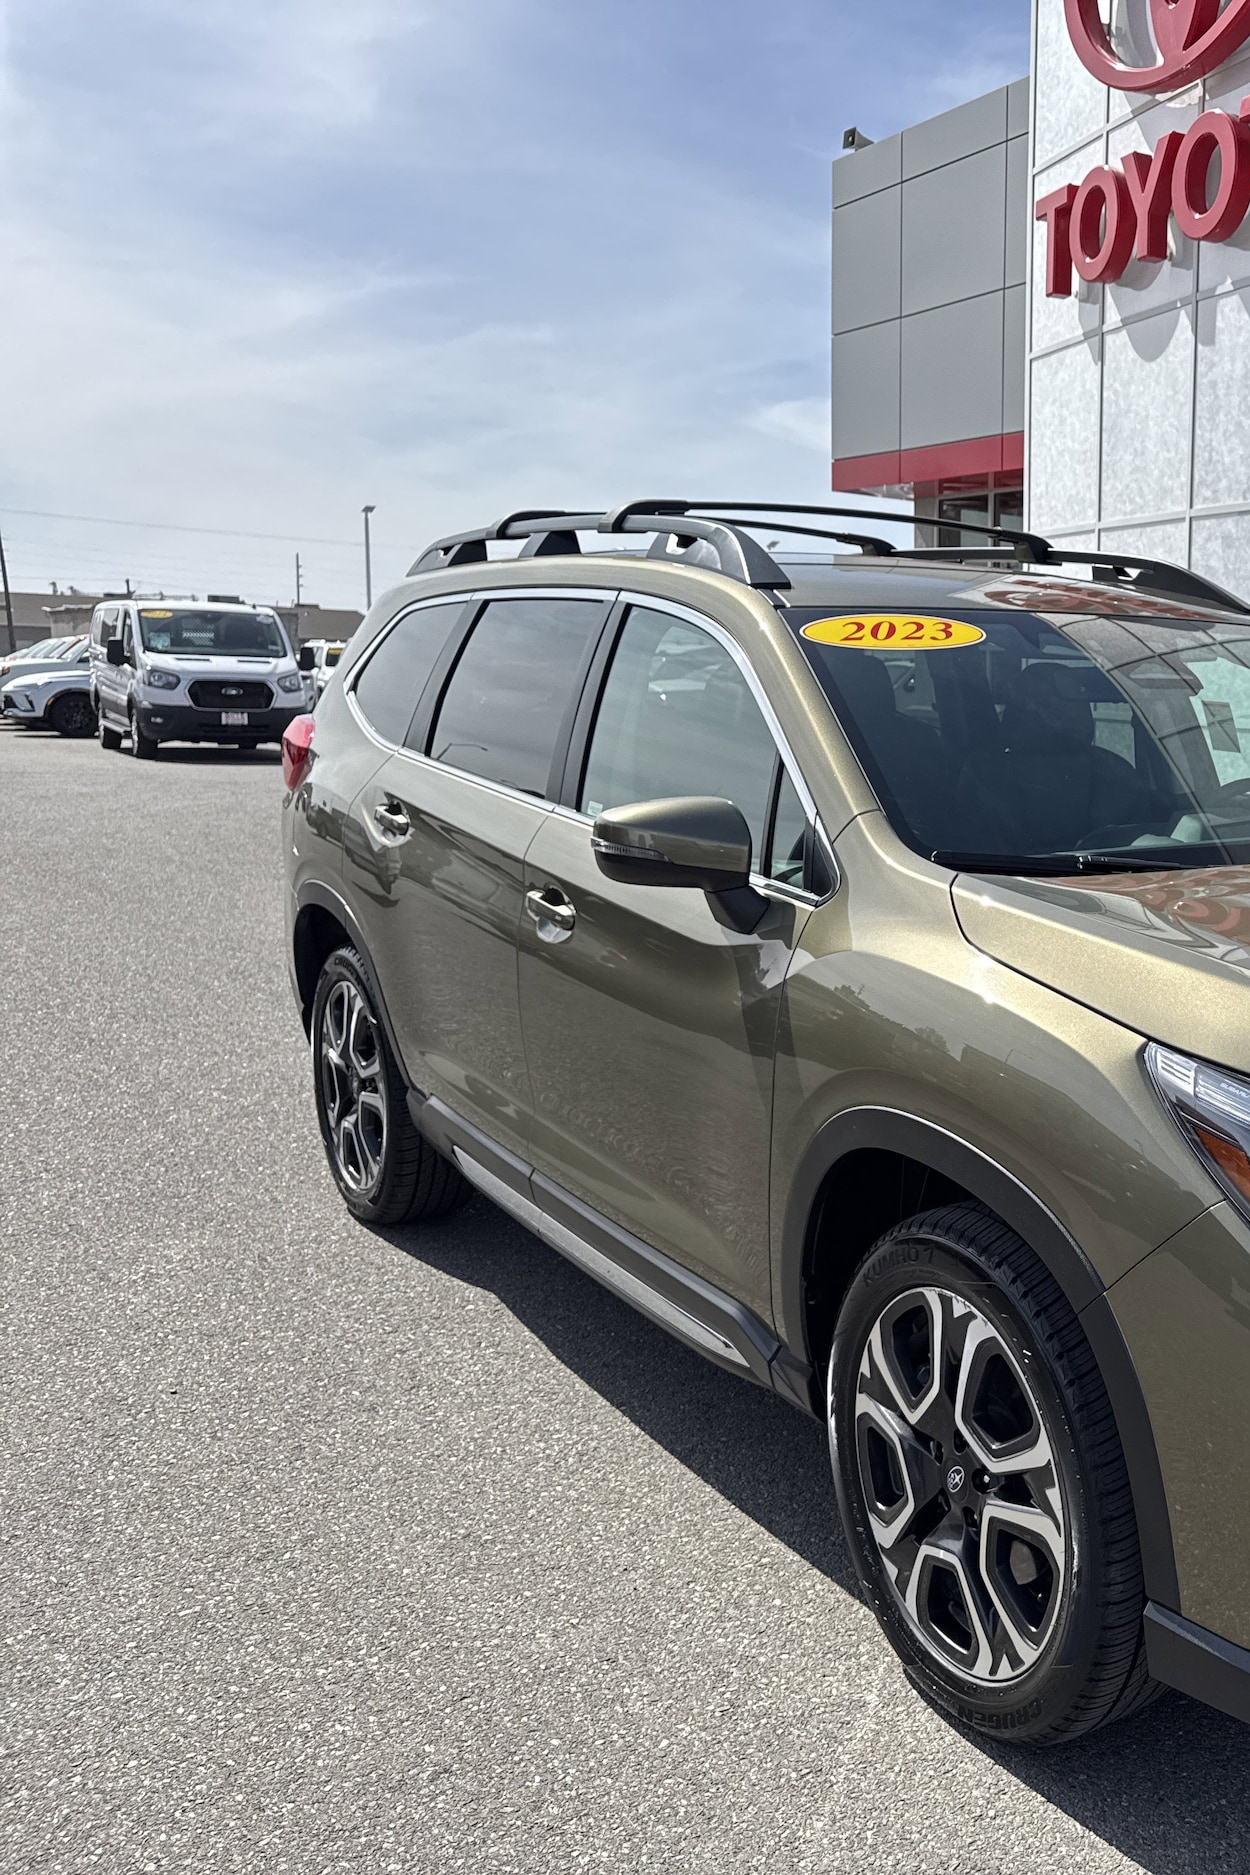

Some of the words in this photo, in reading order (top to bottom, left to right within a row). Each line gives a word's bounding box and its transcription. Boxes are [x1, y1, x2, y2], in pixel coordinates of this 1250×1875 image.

[840, 620, 953, 641] 2023
[862, 1244, 920, 1288] KUMHO
[957, 1698, 1043, 1730] CRUGEN
